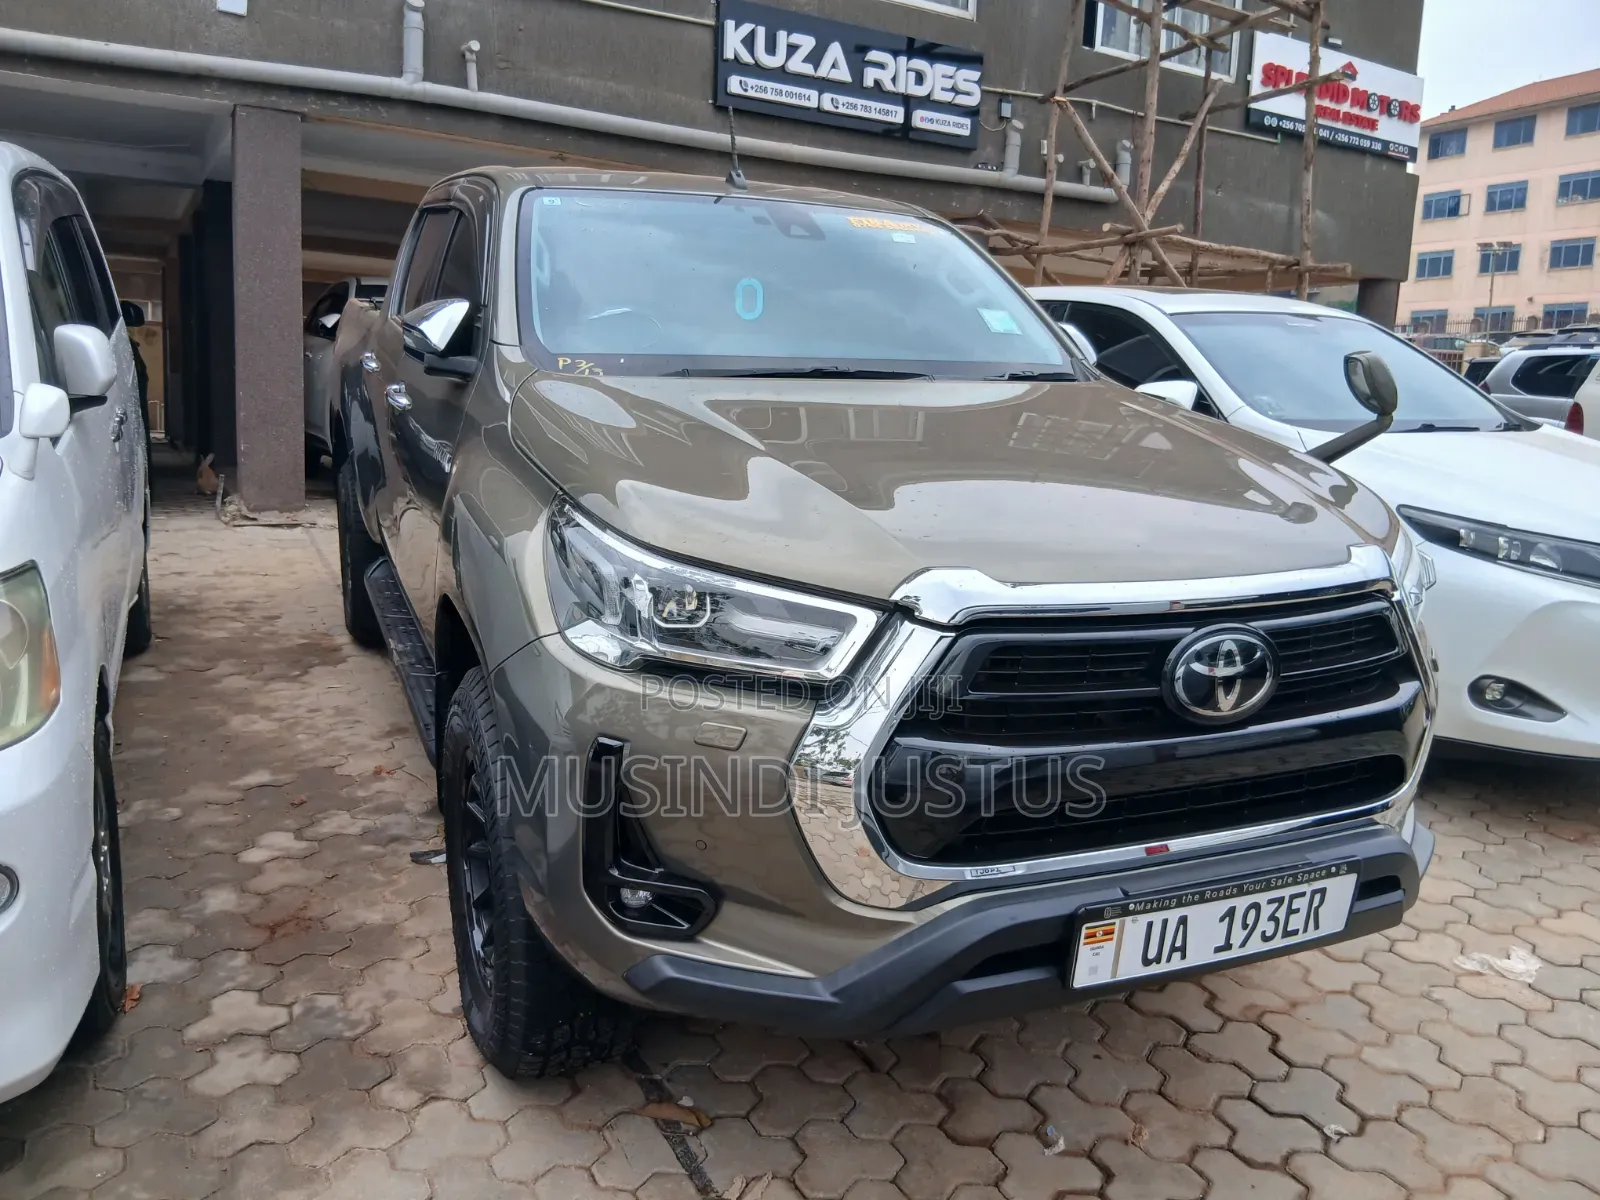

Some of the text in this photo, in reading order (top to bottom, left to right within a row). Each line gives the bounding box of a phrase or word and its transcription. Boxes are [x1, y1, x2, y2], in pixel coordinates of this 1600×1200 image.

[723, 19, 981, 107] KUZA RIDES
[750, 84, 811, 102] +256 758 001614
[841, 101, 898, 118] +256 783 145817
[935, 118, 969, 131] KUZA RIDES
[1279, 120, 1294, 130] +256
[1335, 133, 1349, 142] +256
[1134, 897, 1177, 913] Making
[1181, 893, 1200, 903] the
[1204, 887, 1238, 899] Roads
[1242, 880, 1267, 892] Your
[1270, 876, 1293, 886] Safe
[1297, 870, 1327, 882] Space
[1141, 886, 1328, 967] UA 193ER
